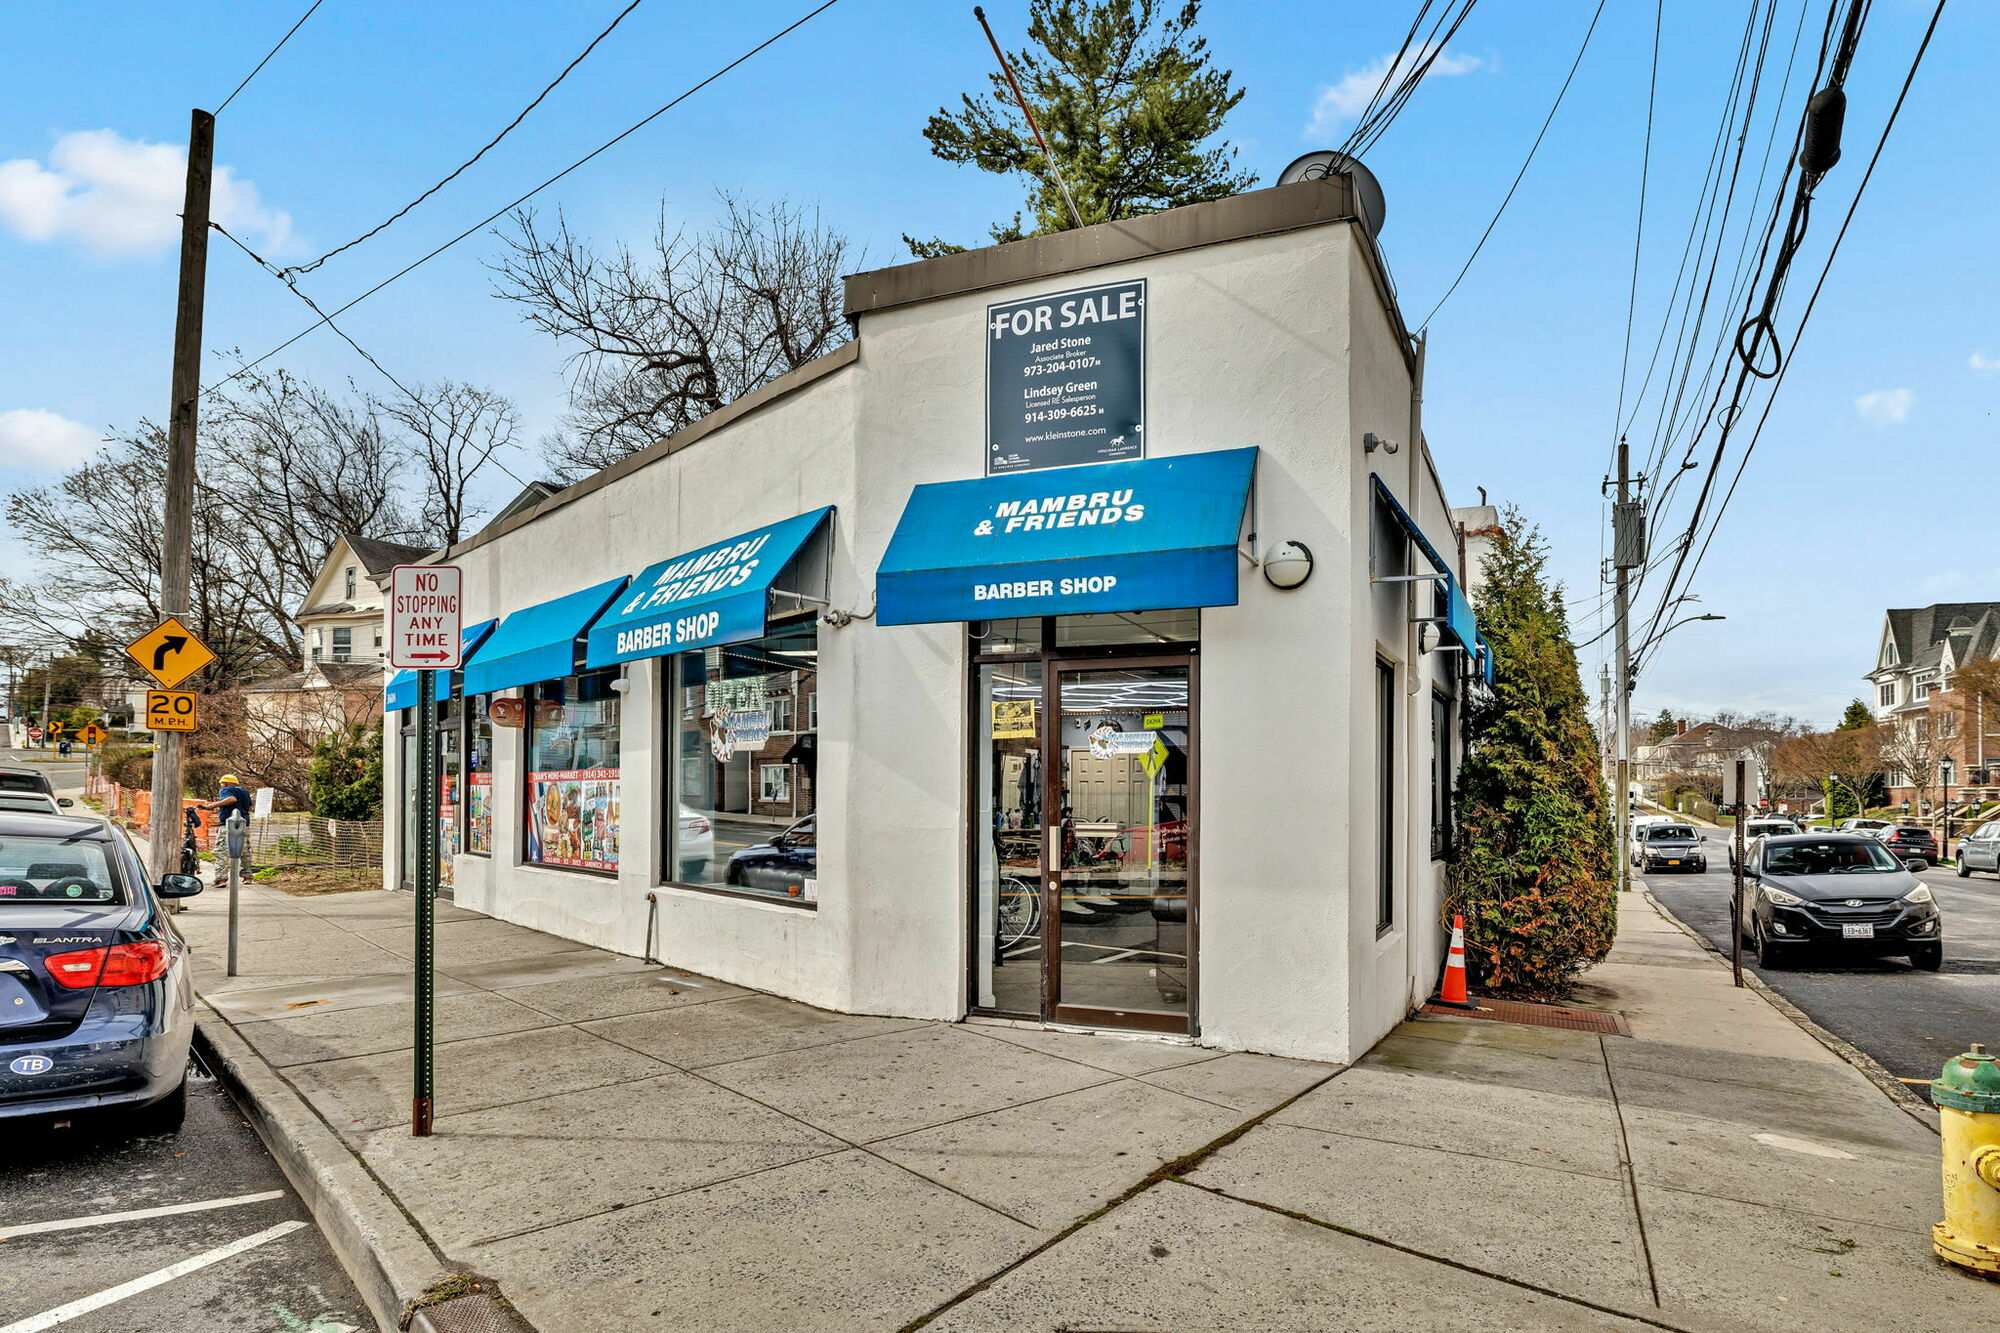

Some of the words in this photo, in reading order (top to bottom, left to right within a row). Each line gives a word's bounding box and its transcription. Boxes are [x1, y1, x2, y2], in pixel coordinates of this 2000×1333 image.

[995, 305, 1053, 340] FOR
[1060, 291, 1137, 328] SALE
[1030, 339, 1059, 354] Jared
[1060, 336, 1091, 349] Stone
[1035, 354, 1064, 363] Associate
[1065, 350, 1087, 359] Broker
[1024, 357, 1095, 377] 973-204-0107
[1024, 385, 1064, 399] Lindsey
[1065, 381, 1097, 393] Green
[1025, 399, 1050, 409] Licensed
[1051, 397, 1060, 405] RE
[1061, 394, 1096, 404] Salesperson
[1025, 404, 1097, 423] 914-309-6625
[1025, 427, 1106, 443] www.kleinstone.com
[995, 488, 1134, 519] MAMBRU
[973, 520, 995, 536] &
[1004, 504, 1145, 534] FRIENDS
[653, 533, 771, 587] MAMBRU
[416, 573, 438, 592] NO
[622, 591, 647, 616] &
[641, 559, 759, 610] FRIENDS
[974, 580, 1053, 601] BARBER
[1059, 575, 1117, 596] SHOP
[397, 595, 456, 613] STOPPING
[410, 616, 443, 630] ANY
[617, 621, 672, 655] BARBER
[675, 610, 720, 643] SHOP
[404, 633, 448, 646] TIME
[151, 694, 193, 715] 20
[33, 936, 103, 944] ELANTRA
[21, 1059, 44, 1072] TB
